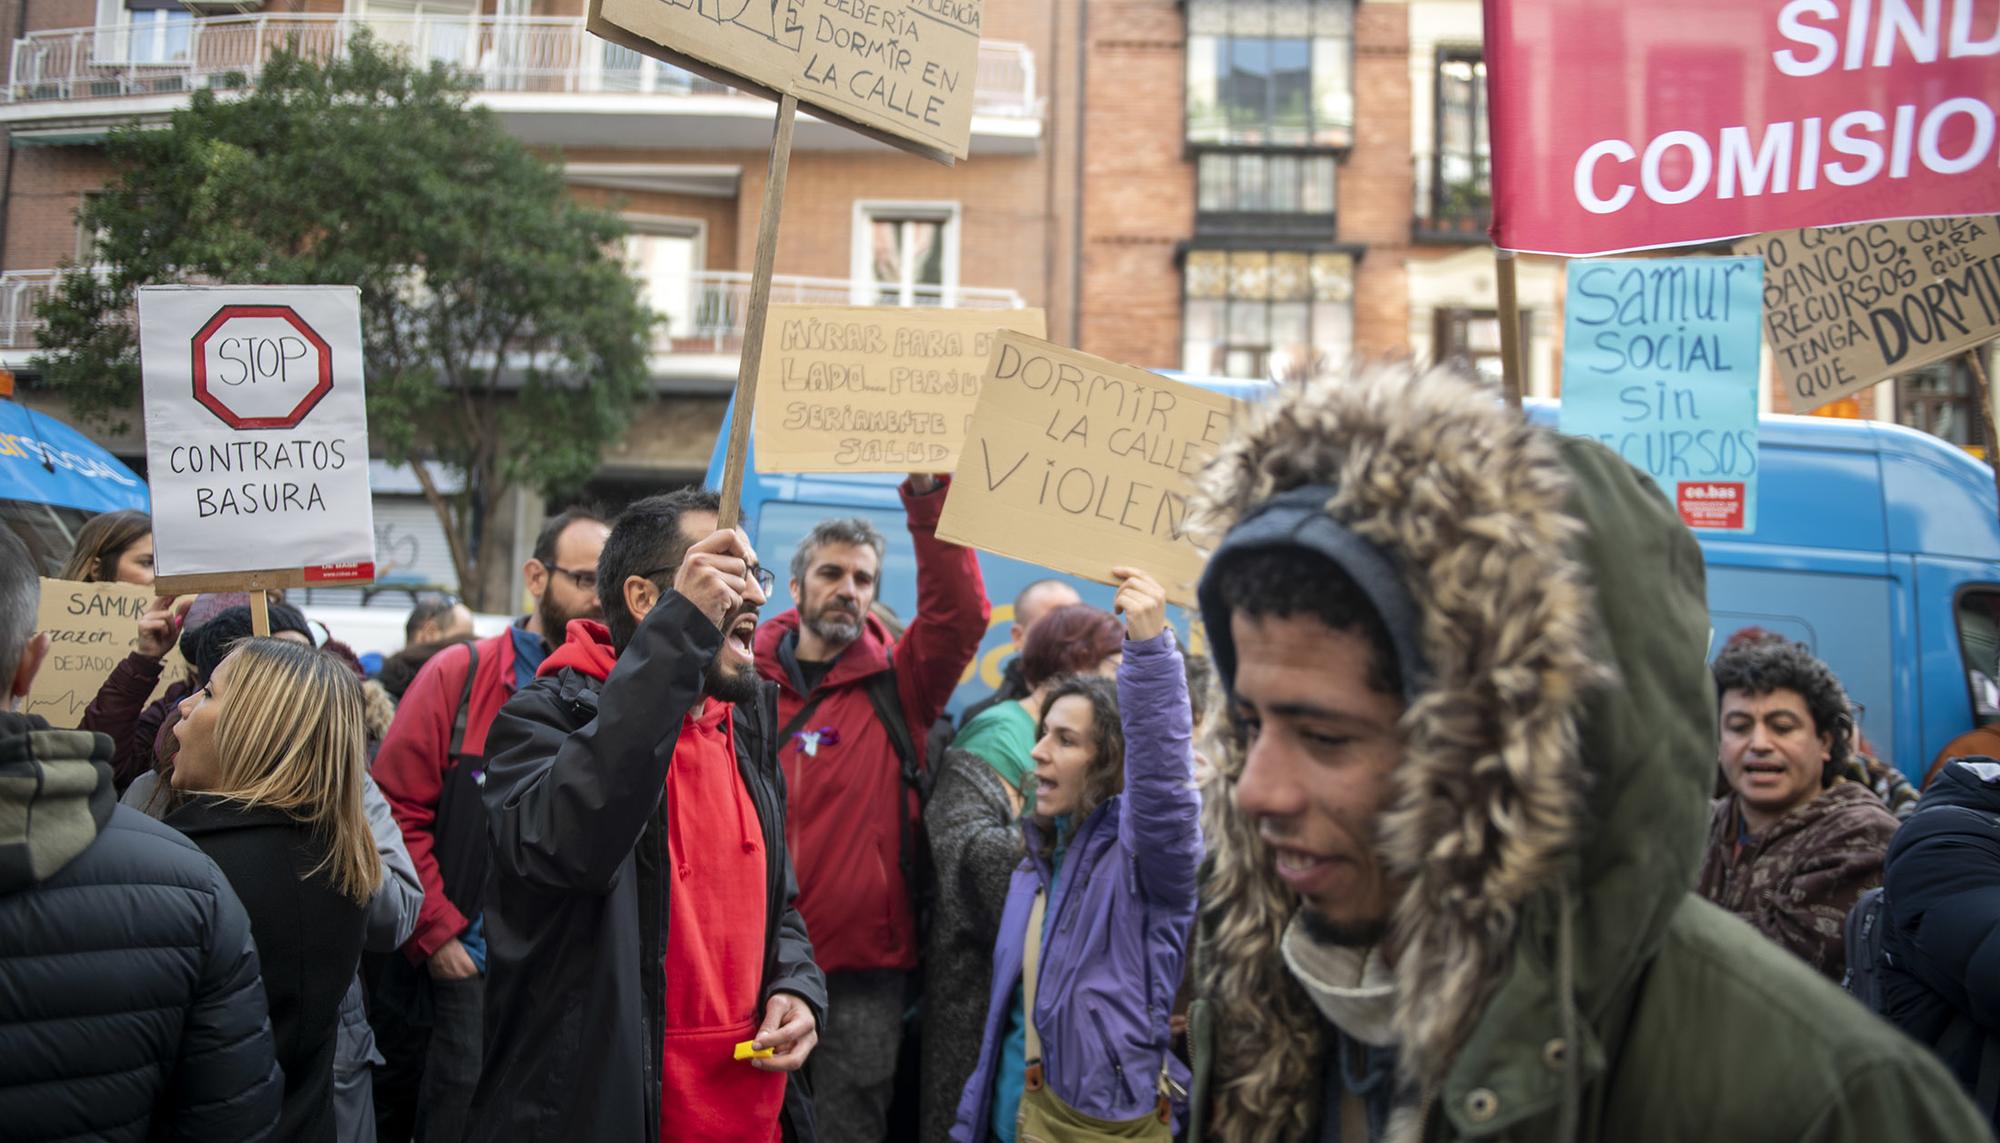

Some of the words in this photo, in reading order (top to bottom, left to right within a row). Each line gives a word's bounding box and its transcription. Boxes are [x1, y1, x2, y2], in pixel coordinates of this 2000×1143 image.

[804, 54, 838, 90] LA
[850, 70, 945, 127] CALLE
[922, 61, 960, 94] EN
[1573, 97, 2000, 215] COMISIO
[1767, 258, 1916, 344] RECURSOS
[1922, 223, 1987, 262] PARA
[1780, 320, 1870, 369] TENGA
[1931, 247, 1977, 276] QUE
[219, 336, 307, 386] STOP
[893, 327, 962, 358] PARA
[1796, 357, 1856, 398] QUE
[170, 439, 346, 474] CONTRATOS
[834, 438, 950, 465] SALUD
[1046, 408, 1088, 449] LA
[1108, 427, 1202, 476] CALLE
[1574, 428, 1757, 478] CURSOS
[196, 482, 326, 518] BASURA
[67, 592, 148, 620] SAMUR
[54, 655, 114, 672] DEJADO
